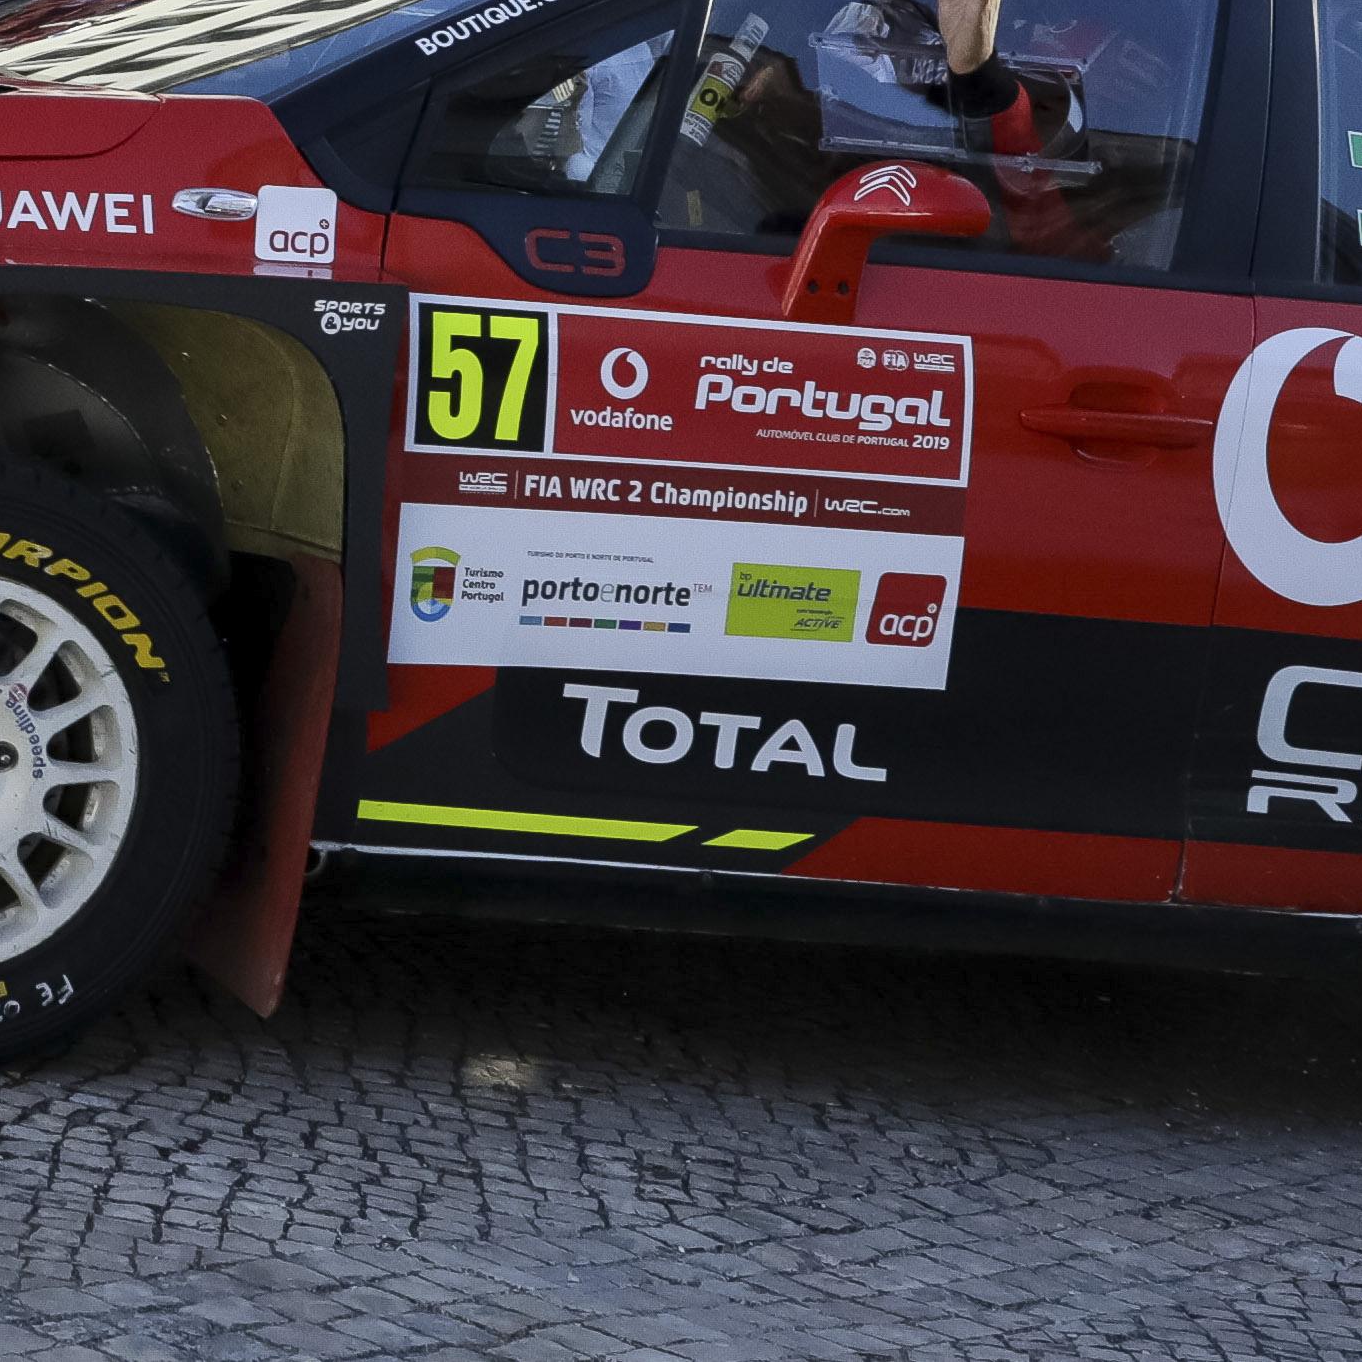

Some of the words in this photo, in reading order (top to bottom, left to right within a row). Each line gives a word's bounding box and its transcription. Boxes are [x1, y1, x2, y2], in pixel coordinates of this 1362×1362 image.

[268, 229, 331, 259] acp
[524, 227, 626, 277] C3
[314, 299, 387, 317] SPORTS
[699, 353, 758, 376] rally
[762, 356, 794, 374] de
[882, 352, 908, 369] FIA
[428, 311, 540, 441] 57
[694, 373, 951, 431] Portugal
[570, 405, 673, 431] vodafone
[756, 428, 815, 442] AUTOMÓVEL
[842, 434, 856, 444] DE
[856, 435, 910, 448] PORTUGAL
[911, 434, 951, 450] 2019
[459, 471, 509, 485] WRC
[524, 474, 563, 499] FIA
[569, 476, 622, 502] WRC
[627, 480, 642, 503] 2
[650, 481, 809, 516] Championship
[462, 578, 496, 590] Centro
[464, 567, 505, 579] Turismo
[461, 590, 505, 604] Portugal
[737, 578, 832, 602] ultimate
[794, 617, 843, 629] ACTIVE
[879, 613, 935, 642] acp
[5, 698, 48, 780] speedline
[562, 682, 888, 783] TOTAL
